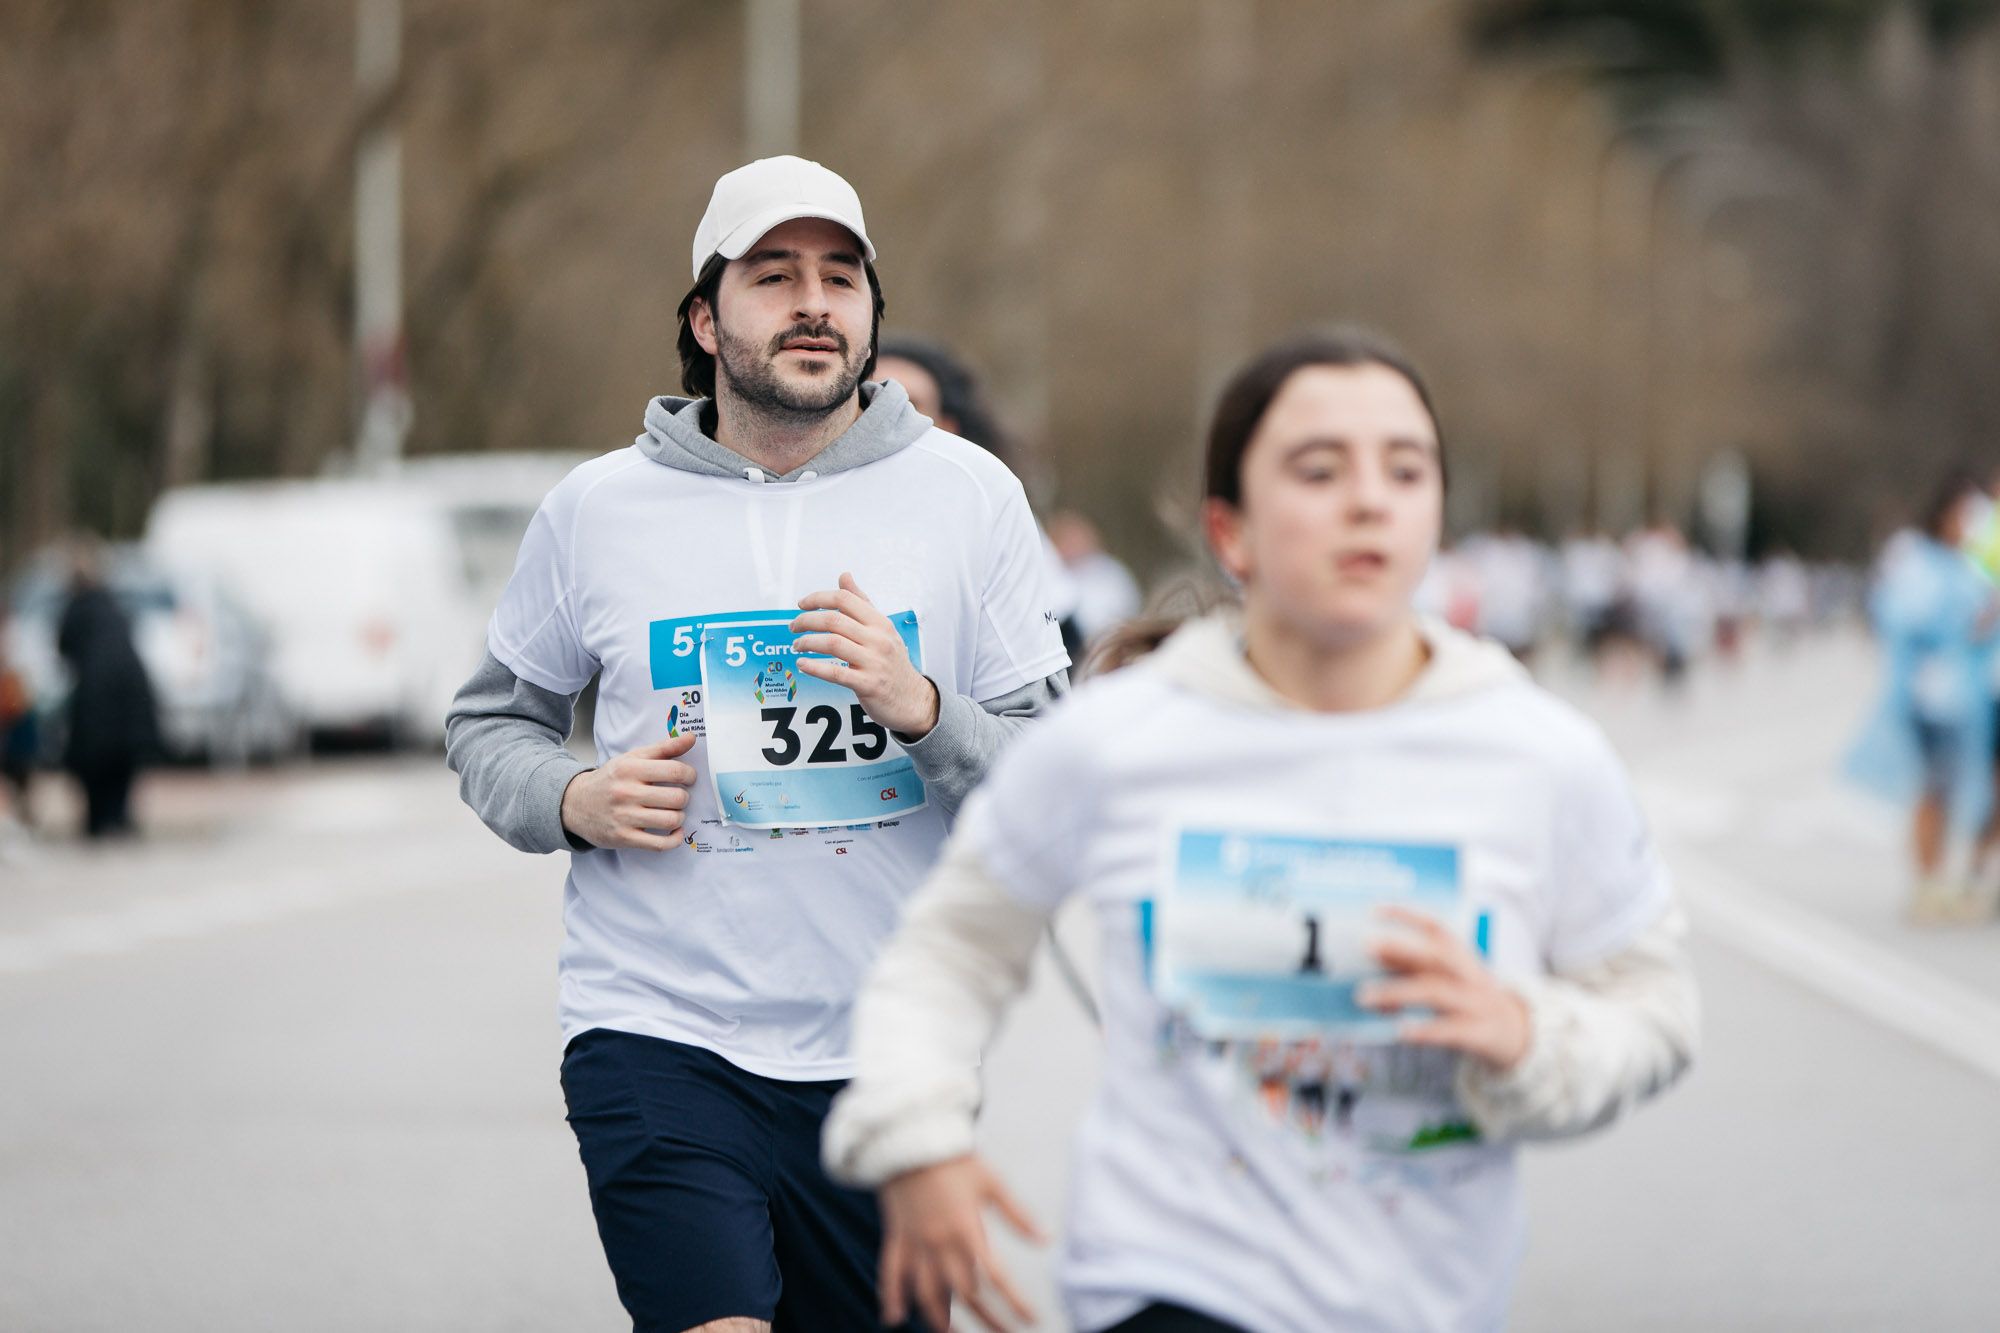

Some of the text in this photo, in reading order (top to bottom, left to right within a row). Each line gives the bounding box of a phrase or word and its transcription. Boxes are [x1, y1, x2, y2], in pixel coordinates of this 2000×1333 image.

[752, 641, 814, 657] Carre
[767, 661, 783, 673] 20
[681, 690, 702, 706] 20
[680, 717, 704, 725] Mundial
[761, 704, 888, 766] 325
[880, 787, 899, 801] CSL
[835, 847, 848, 855] CSL
[1301, 913, 1322, 972] 1
